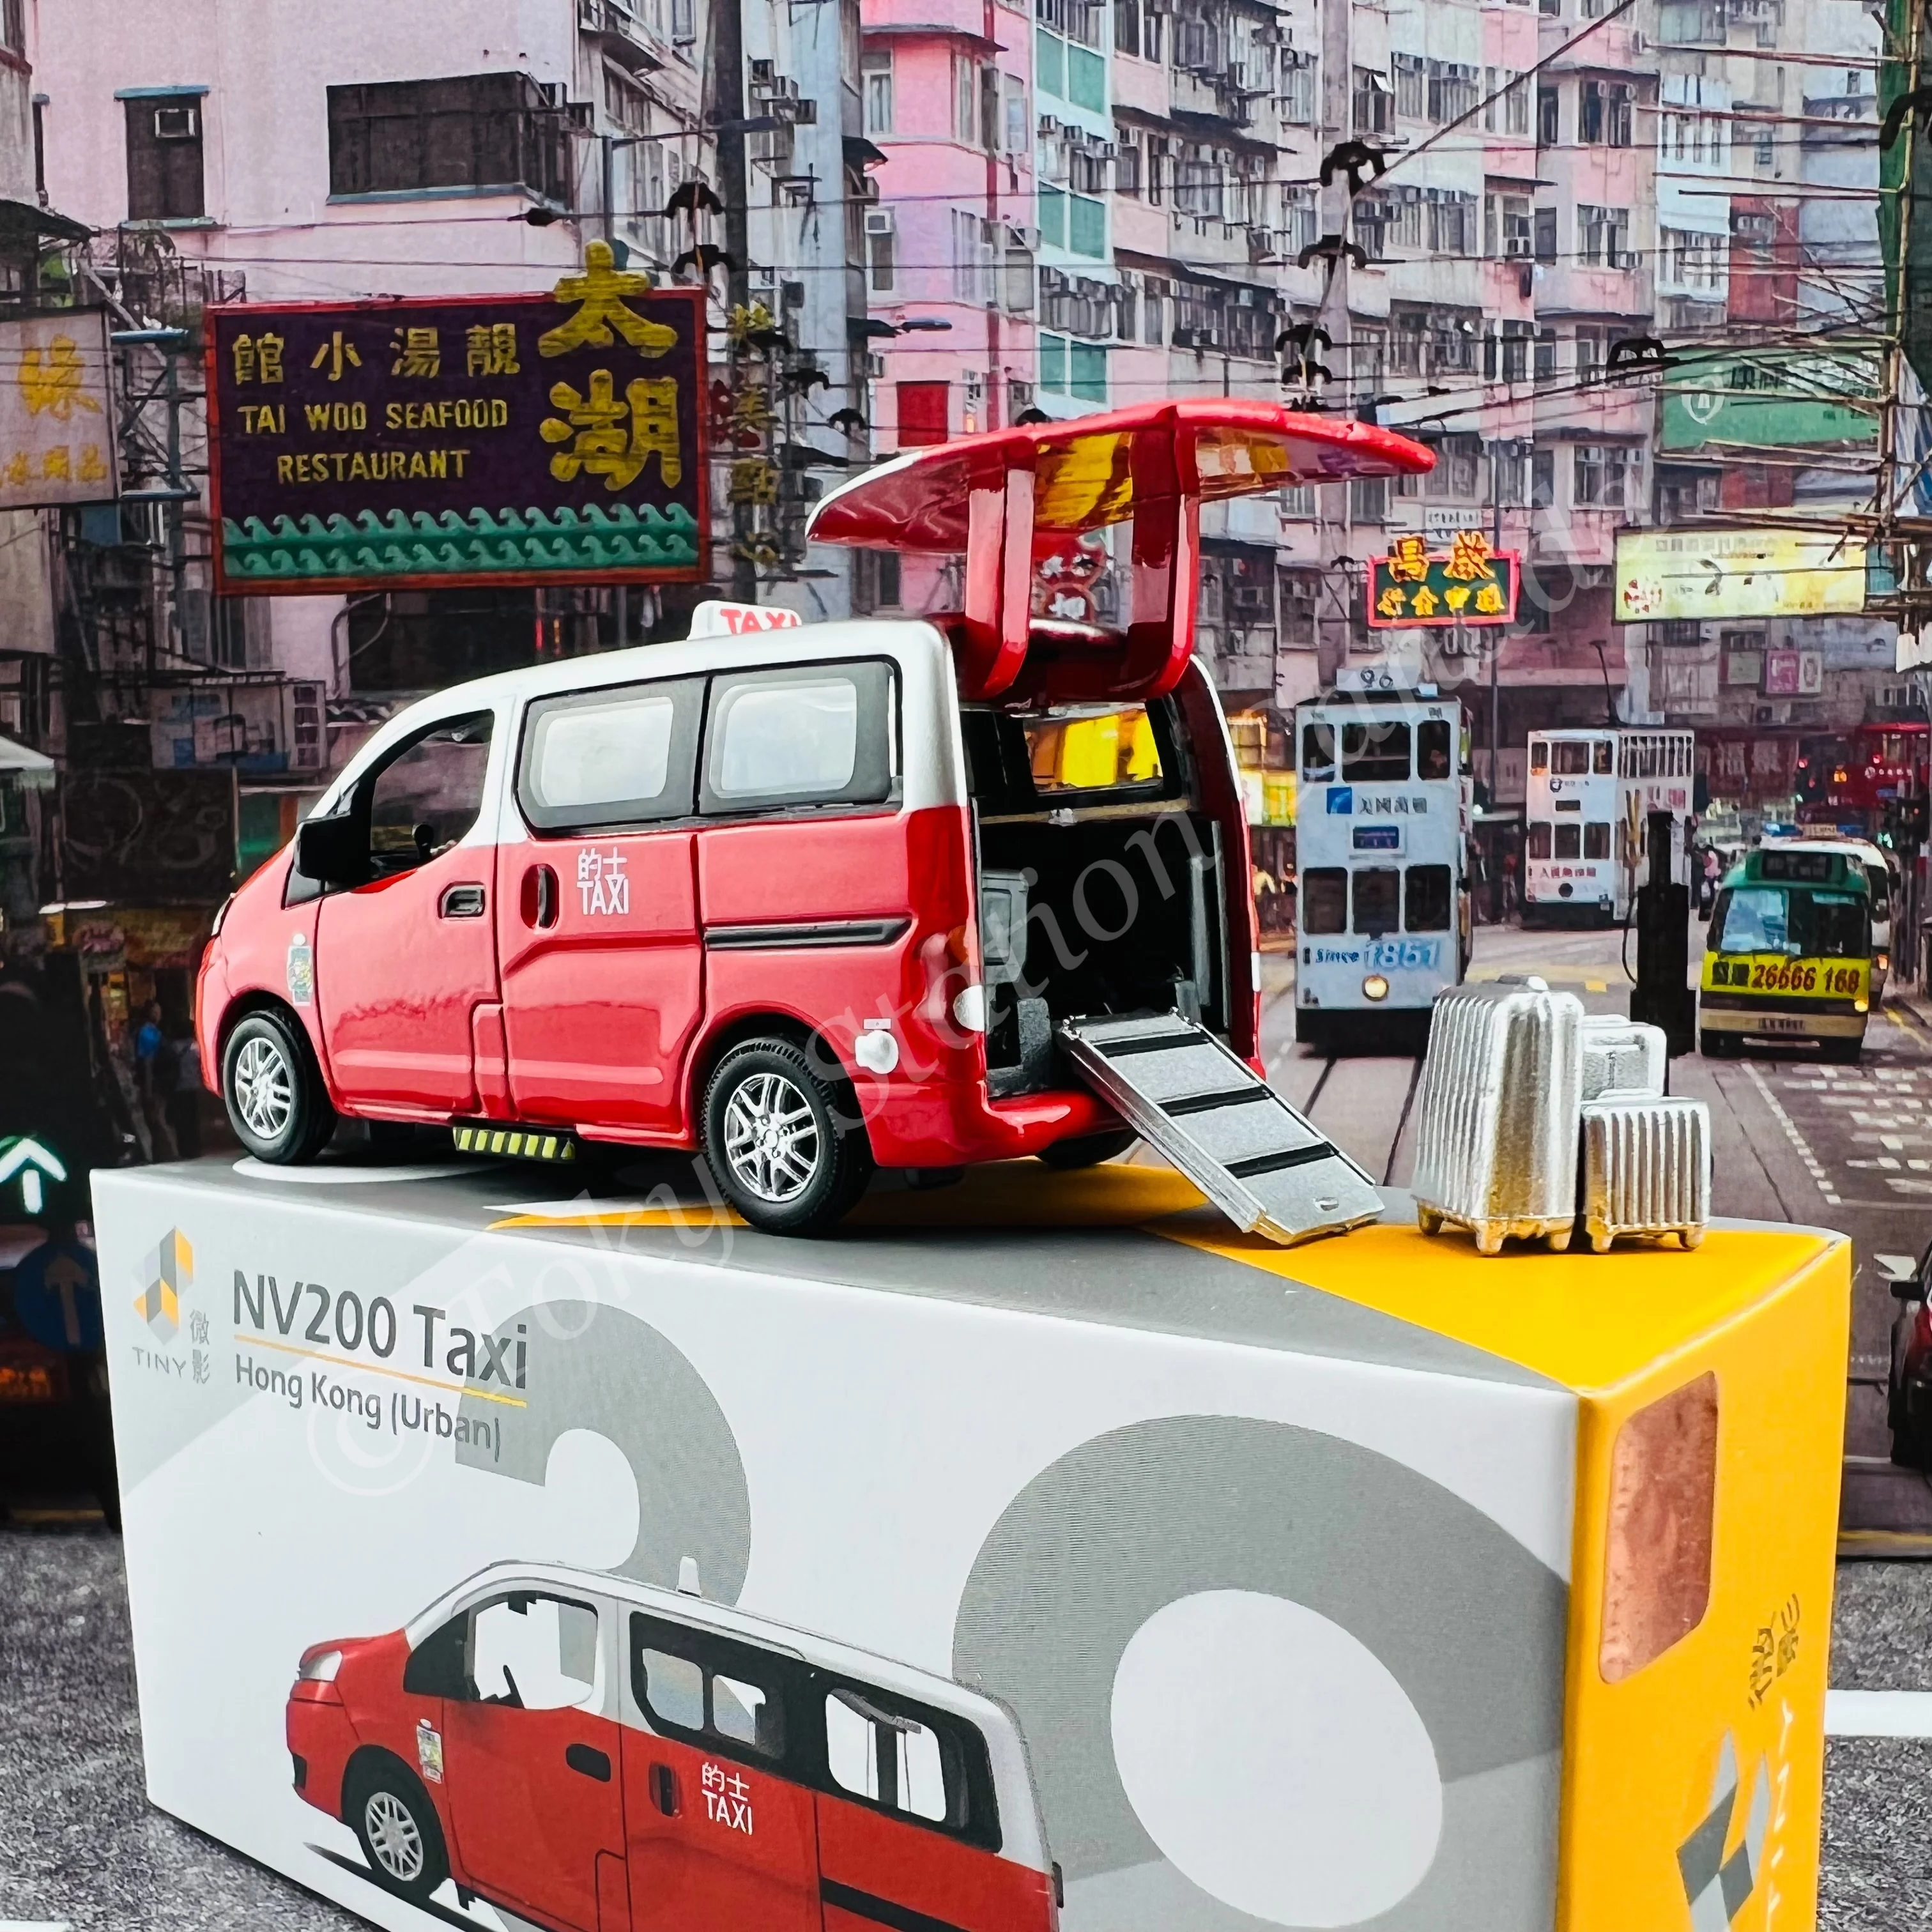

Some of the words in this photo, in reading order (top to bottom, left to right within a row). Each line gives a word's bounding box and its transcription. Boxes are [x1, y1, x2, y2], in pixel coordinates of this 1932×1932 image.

[537, 238, 681, 491] 太湖
[237, 405, 286, 435] TAI
[305, 401, 367, 432] WOO
[385, 399, 509, 430] SEAFOOD
[277, 449, 471, 486] RESTAURANT
[578, 846, 628, 881] 的士
[576, 875, 629, 915] TAXI
[1751, 963, 1817, 992] 26666
[233, 1269, 396, 1358] NV200
[413, 1304, 528, 1389] Taxi
[132, 1346, 187, 1379] TINY
[235, 1353, 303, 1409] Hong
[312, 1371, 381, 1430] Kong
[391, 1392, 502, 1463] (Urban)
[702, 1761, 750, 1802] 的士
[701, 1788, 754, 1836] TAXI
